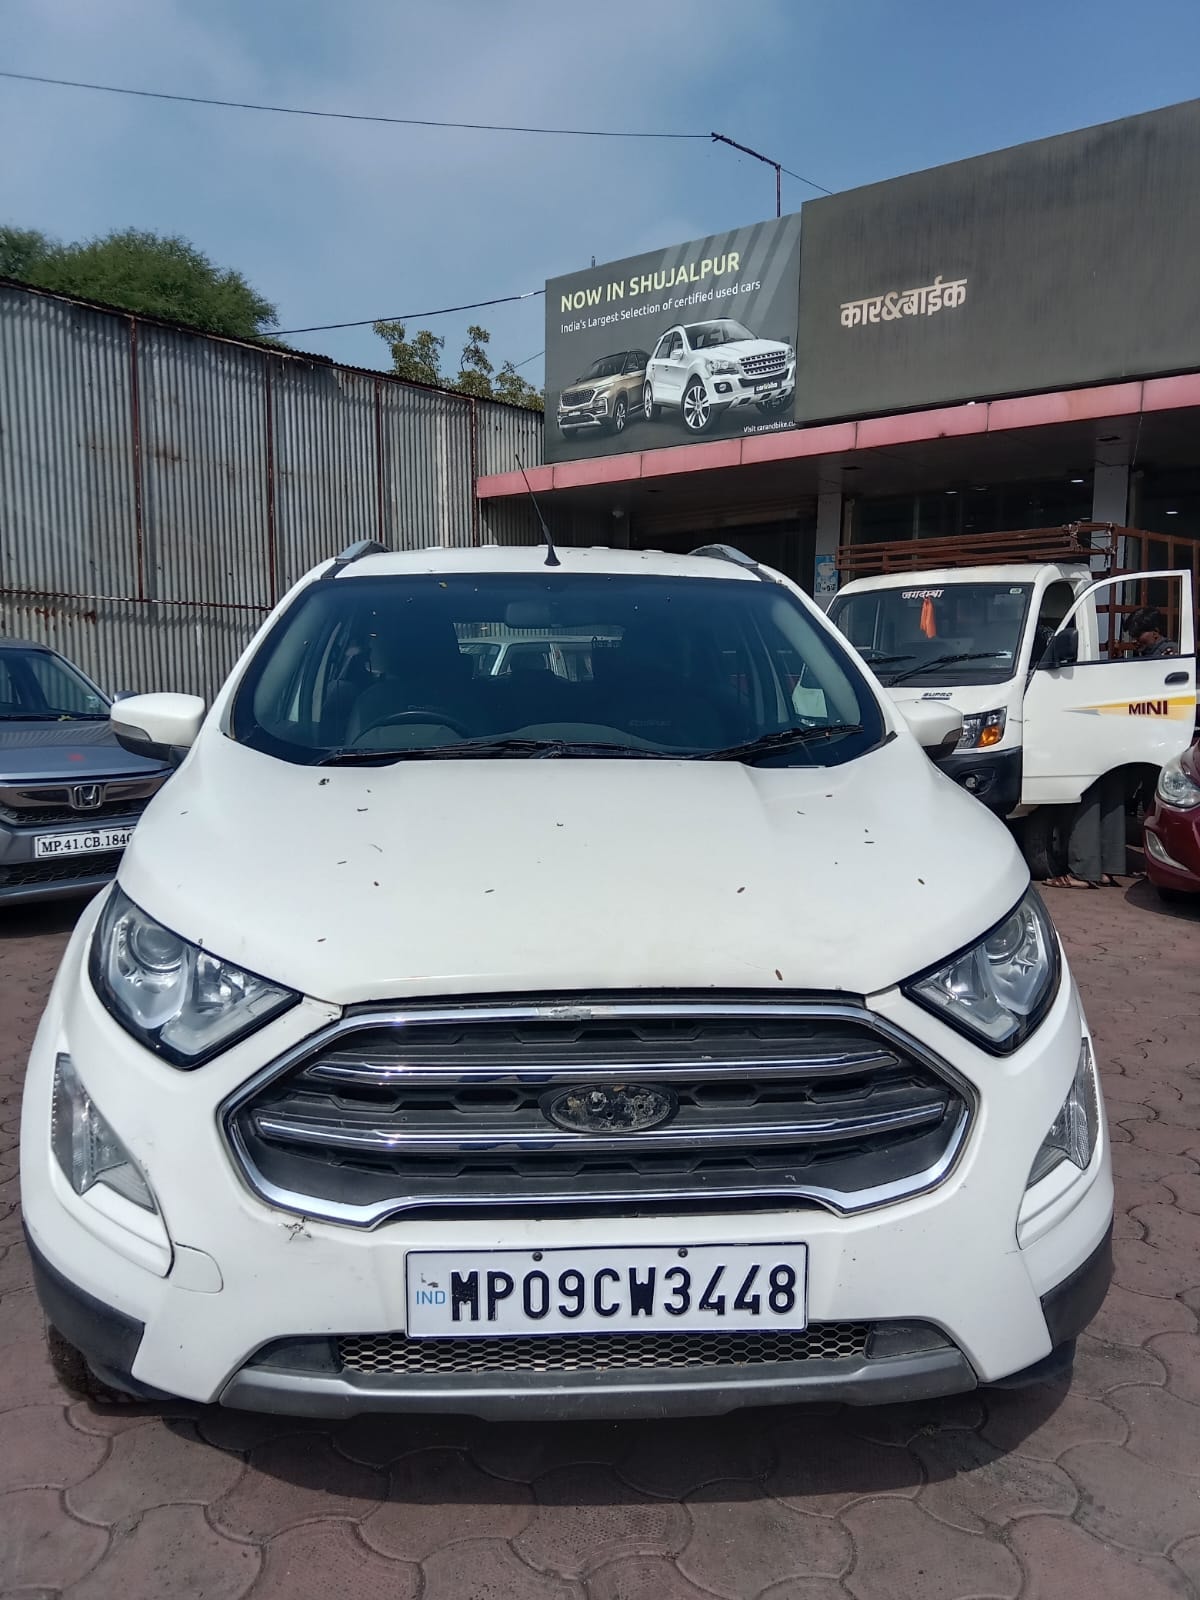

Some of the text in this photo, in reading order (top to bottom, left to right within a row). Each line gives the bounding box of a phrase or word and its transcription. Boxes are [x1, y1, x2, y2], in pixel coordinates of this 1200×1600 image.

[561, 252, 740, 313] NOW IN SHUJALPUR
[561, 279, 761, 334] India's Largest Selection of certified used cars
[743, 425, 756, 433] Visit
[1128, 700, 1168, 716] MINI
[415, 1263, 797, 1322] IND MP09CW3448
